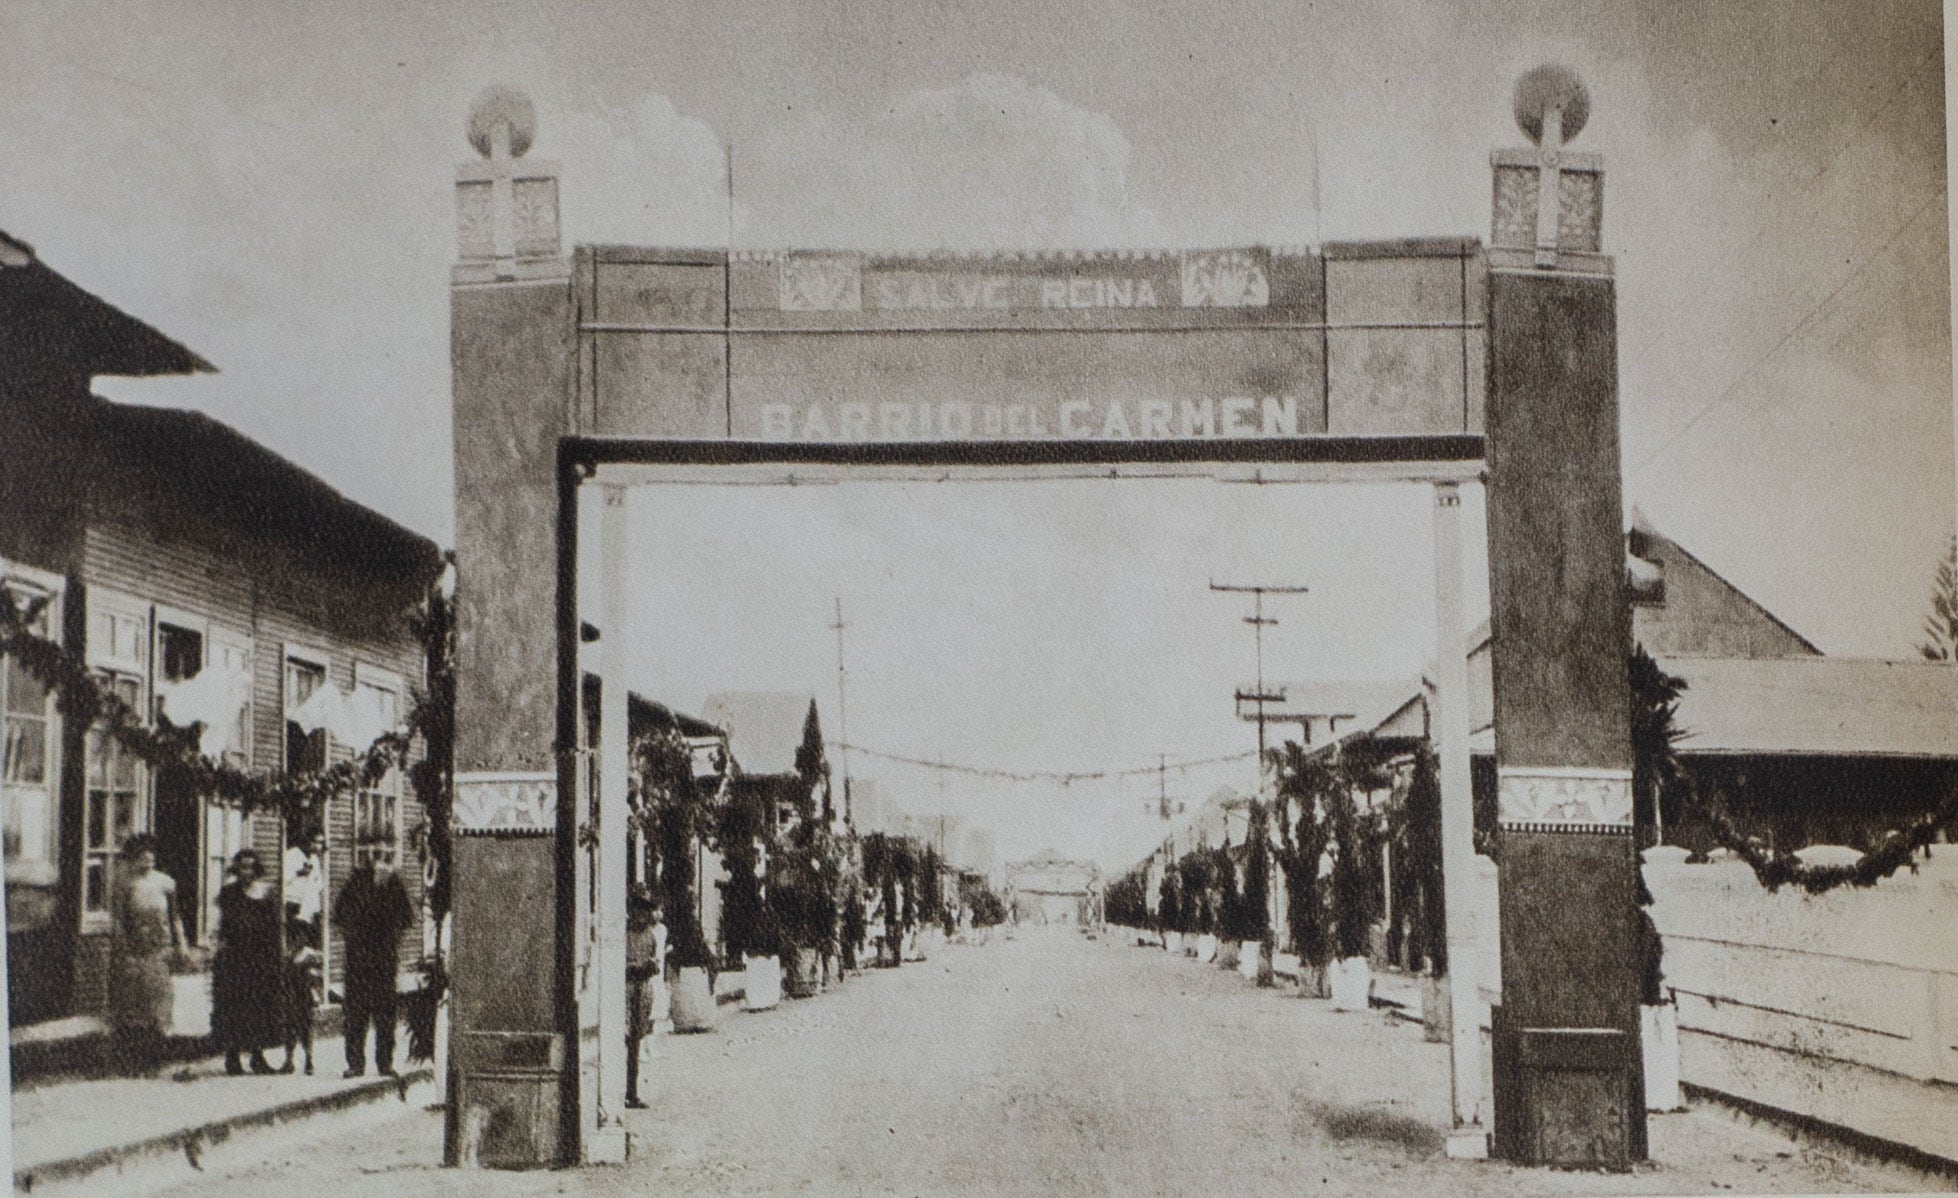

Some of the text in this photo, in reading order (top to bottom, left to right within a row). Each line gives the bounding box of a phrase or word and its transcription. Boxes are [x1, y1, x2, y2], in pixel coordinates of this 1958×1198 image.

[878, 277, 1158, 310] SALVE REINA
[761, 397, 1299, 441] BARRIO DEL CARMEN
